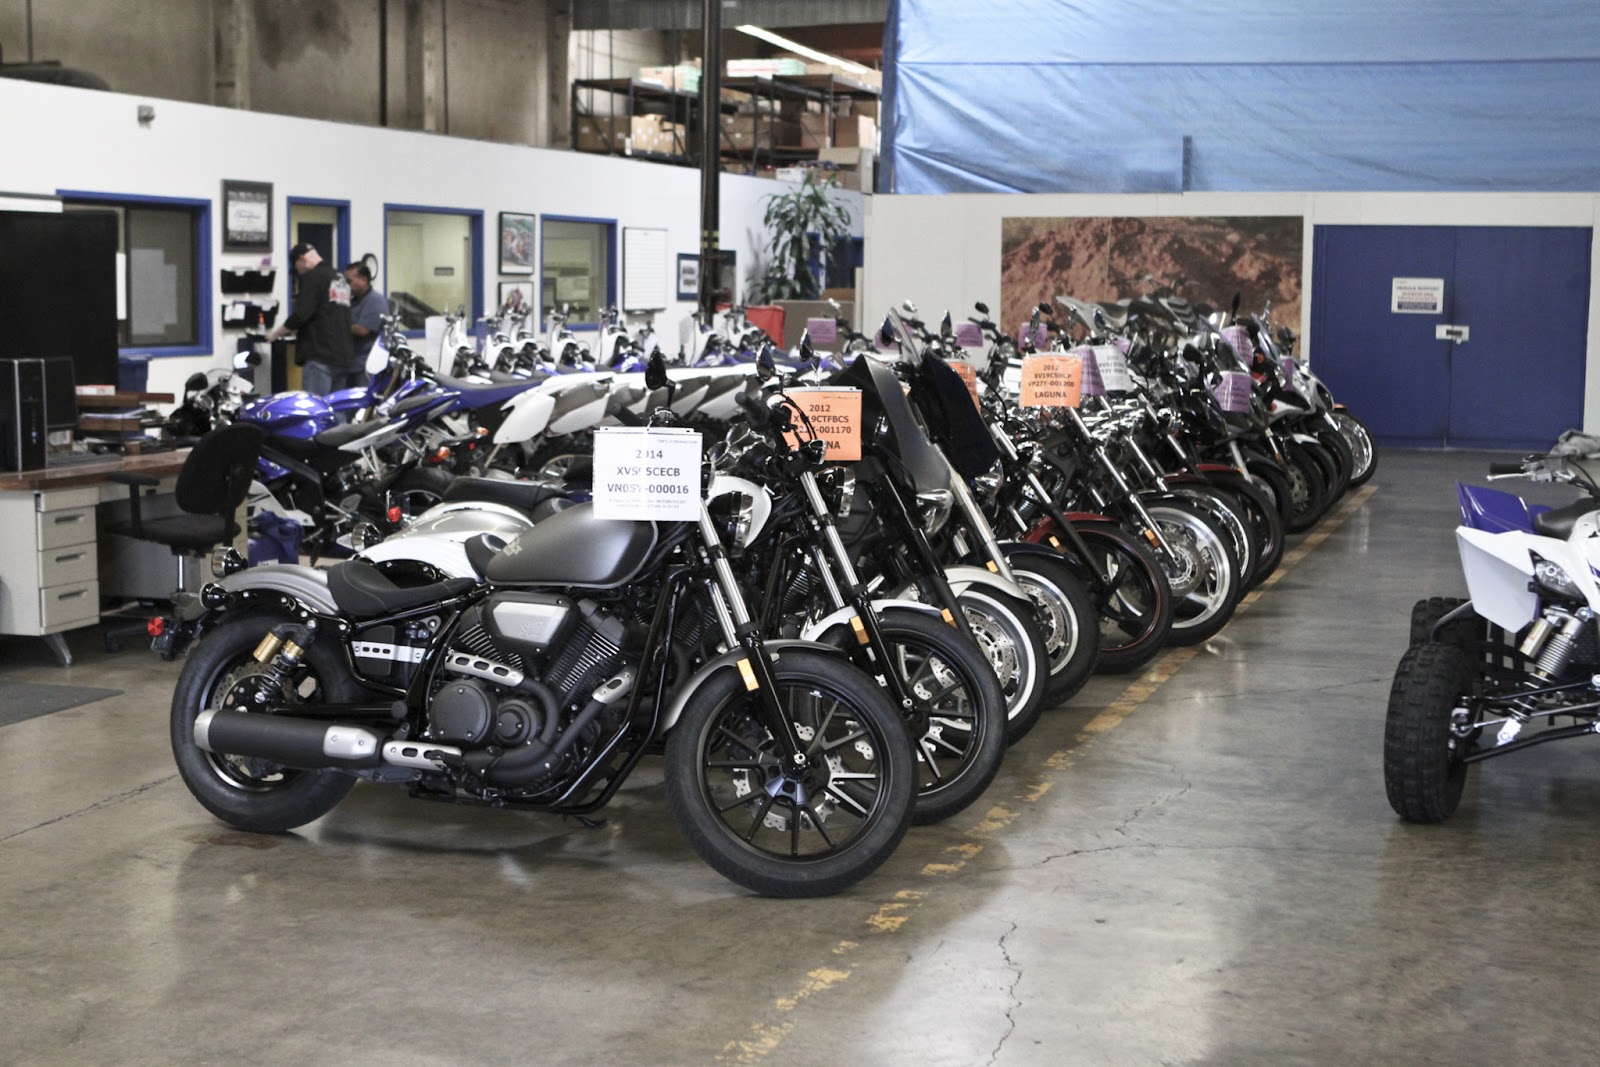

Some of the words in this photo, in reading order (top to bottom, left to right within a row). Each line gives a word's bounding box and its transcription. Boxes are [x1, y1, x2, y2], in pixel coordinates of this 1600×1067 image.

[809, 404, 831, 412] 2012
[793, 415, 849, 423] X9CTFBCS
[616, 466, 681, 477] XVS5CECB
